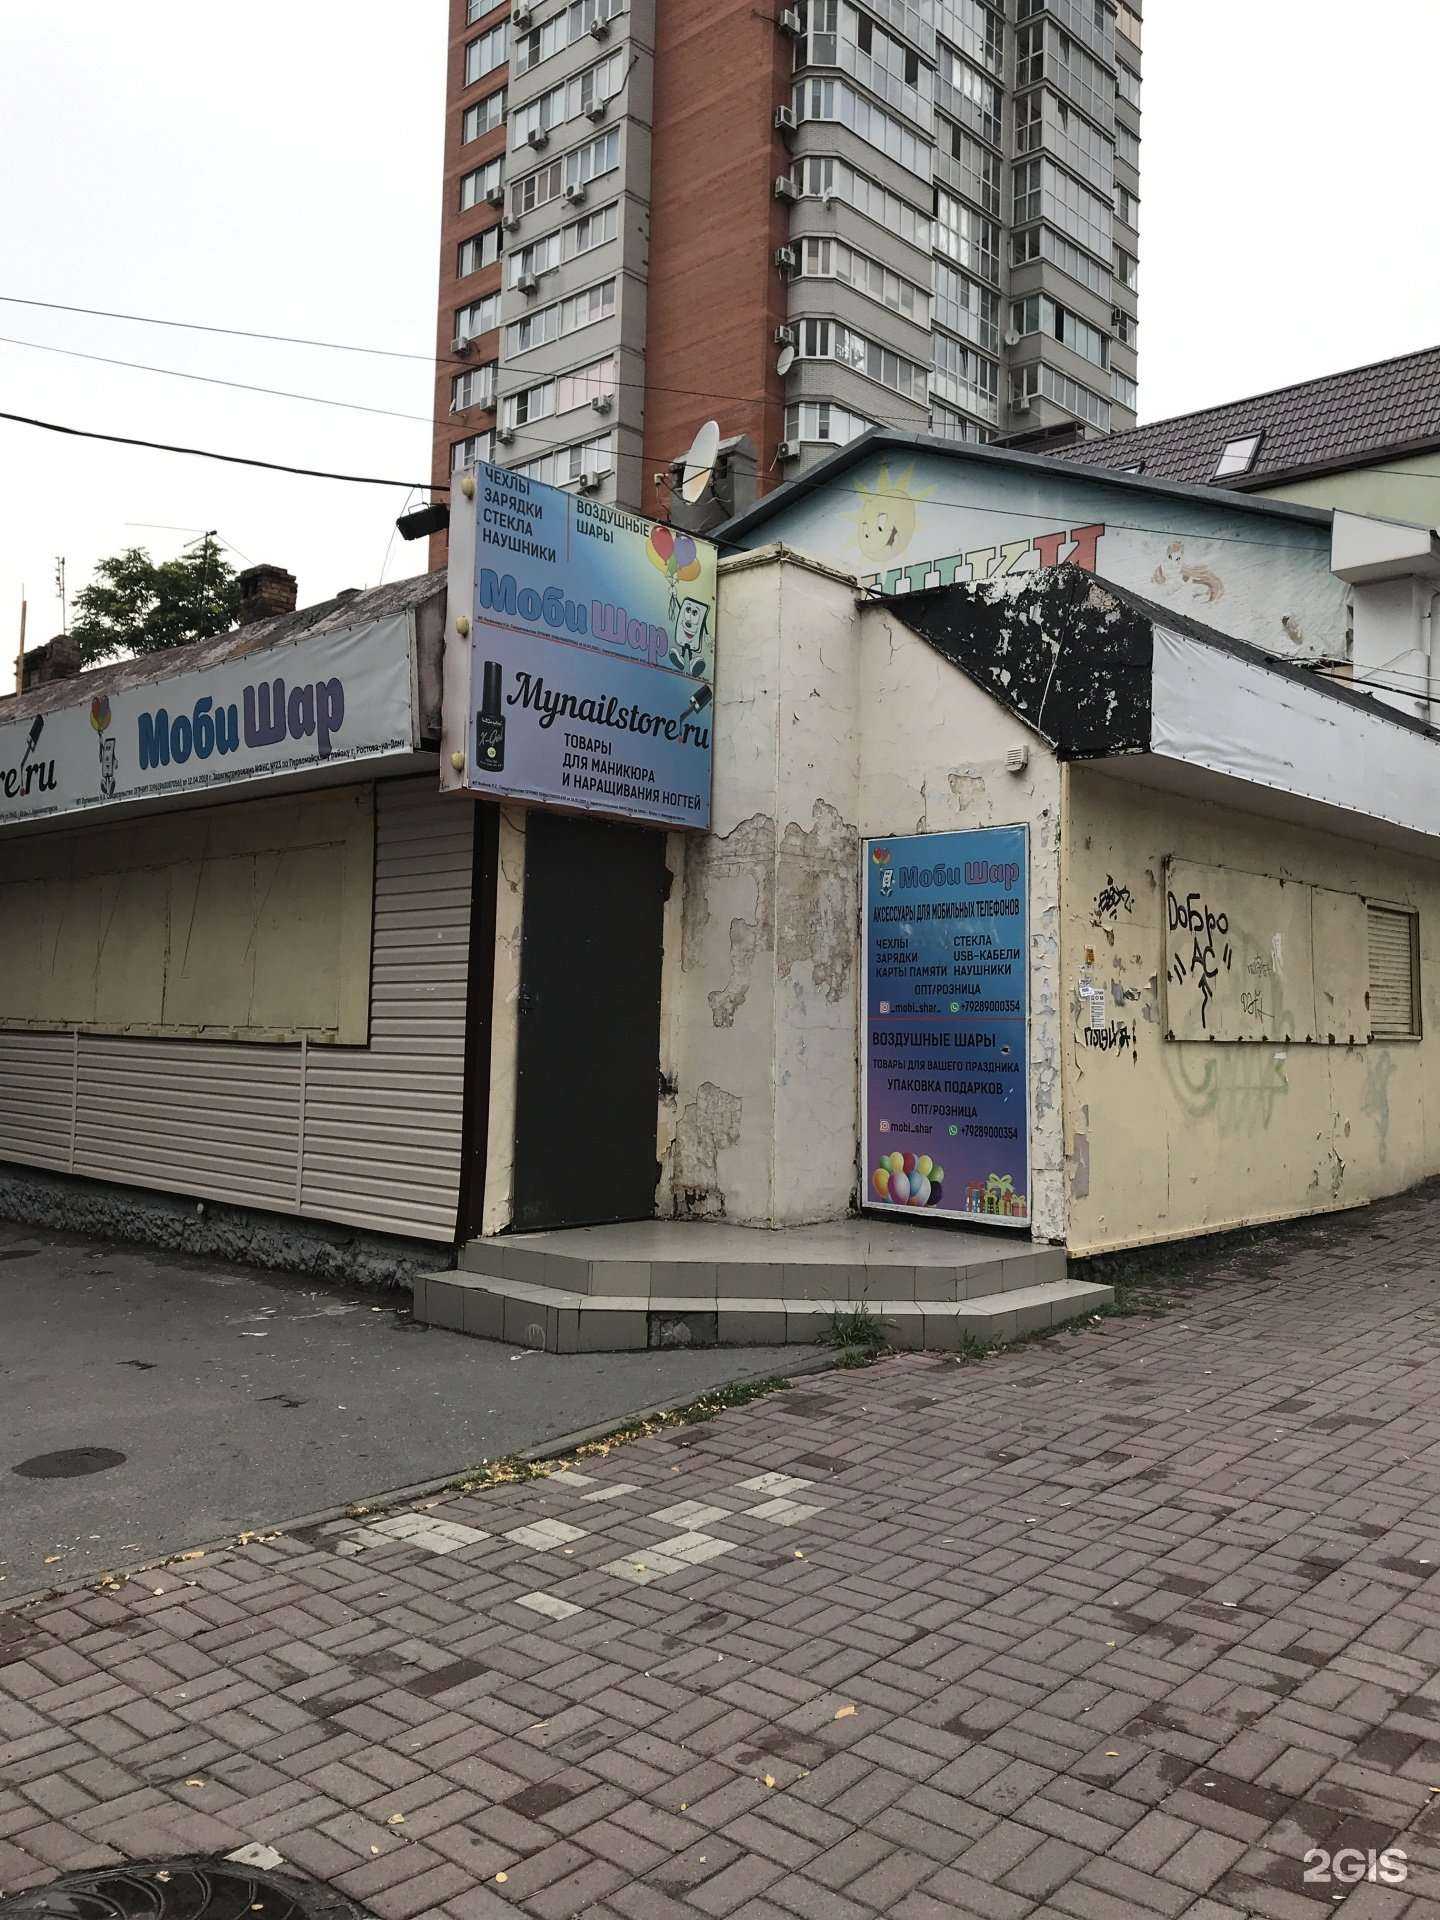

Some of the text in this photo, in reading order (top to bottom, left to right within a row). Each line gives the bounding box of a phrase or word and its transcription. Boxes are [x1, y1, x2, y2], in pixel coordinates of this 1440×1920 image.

[485, 467, 530, 495] ЧЕХЛЫ
[484, 487, 543, 519] ЗАРЯДКИ
[483, 508, 533, 537] СТЕКЛА
[577, 501, 649, 538] ВОЗДУШНЫЕ
[576, 519, 614, 544] ШАРЫ
[482, 528, 556, 563] НАУШНИКИ
[564, 733, 612, 755] ТОВАРЫ
[562, 753, 655, 783] ДЛЯ МАНИКЮРА
[562, 772, 571, 786] И
[573, 777, 660, 803] НАРАЩИВАНИЯ
[663, 791, 701, 811] НОГТЕЙ
[873, 898, 1020, 922] АКСЕССУАРЫ ДЛЯ МОБИЛЬНЫХ ТЕЛЕФОНОВ
[876, 938, 909, 950] ЧЕХЛЫ
[953, 935, 993, 947] СТЕКЛА
[876, 952, 919, 964] ЗАРЯДКИ
[953, 949, 1020, 962] USB-КАБЕЛИ
[876, 965, 948, 978] КАРТЫ ПАМЯТИ
[953, 964, 1012, 976] НАУШНИКИ
[914, 983, 981, 996] ОПТ/РОЗНИЦА
[961, 1000, 1020, 1012] +79289000354
[872, 1032, 996, 1047] ВОЗДУШНЫЕ ШАРЫ
[873, 1059, 1020, 1073] ТОВАРЫ ДЛЯ ВАШЕГО ПРАЗДНИКА
[887, 1079, 1003, 1095] УПАКОВКА ПОДАРКОВ
[911, 1103, 978, 1118] ОПТ/РОЗНИЦА
